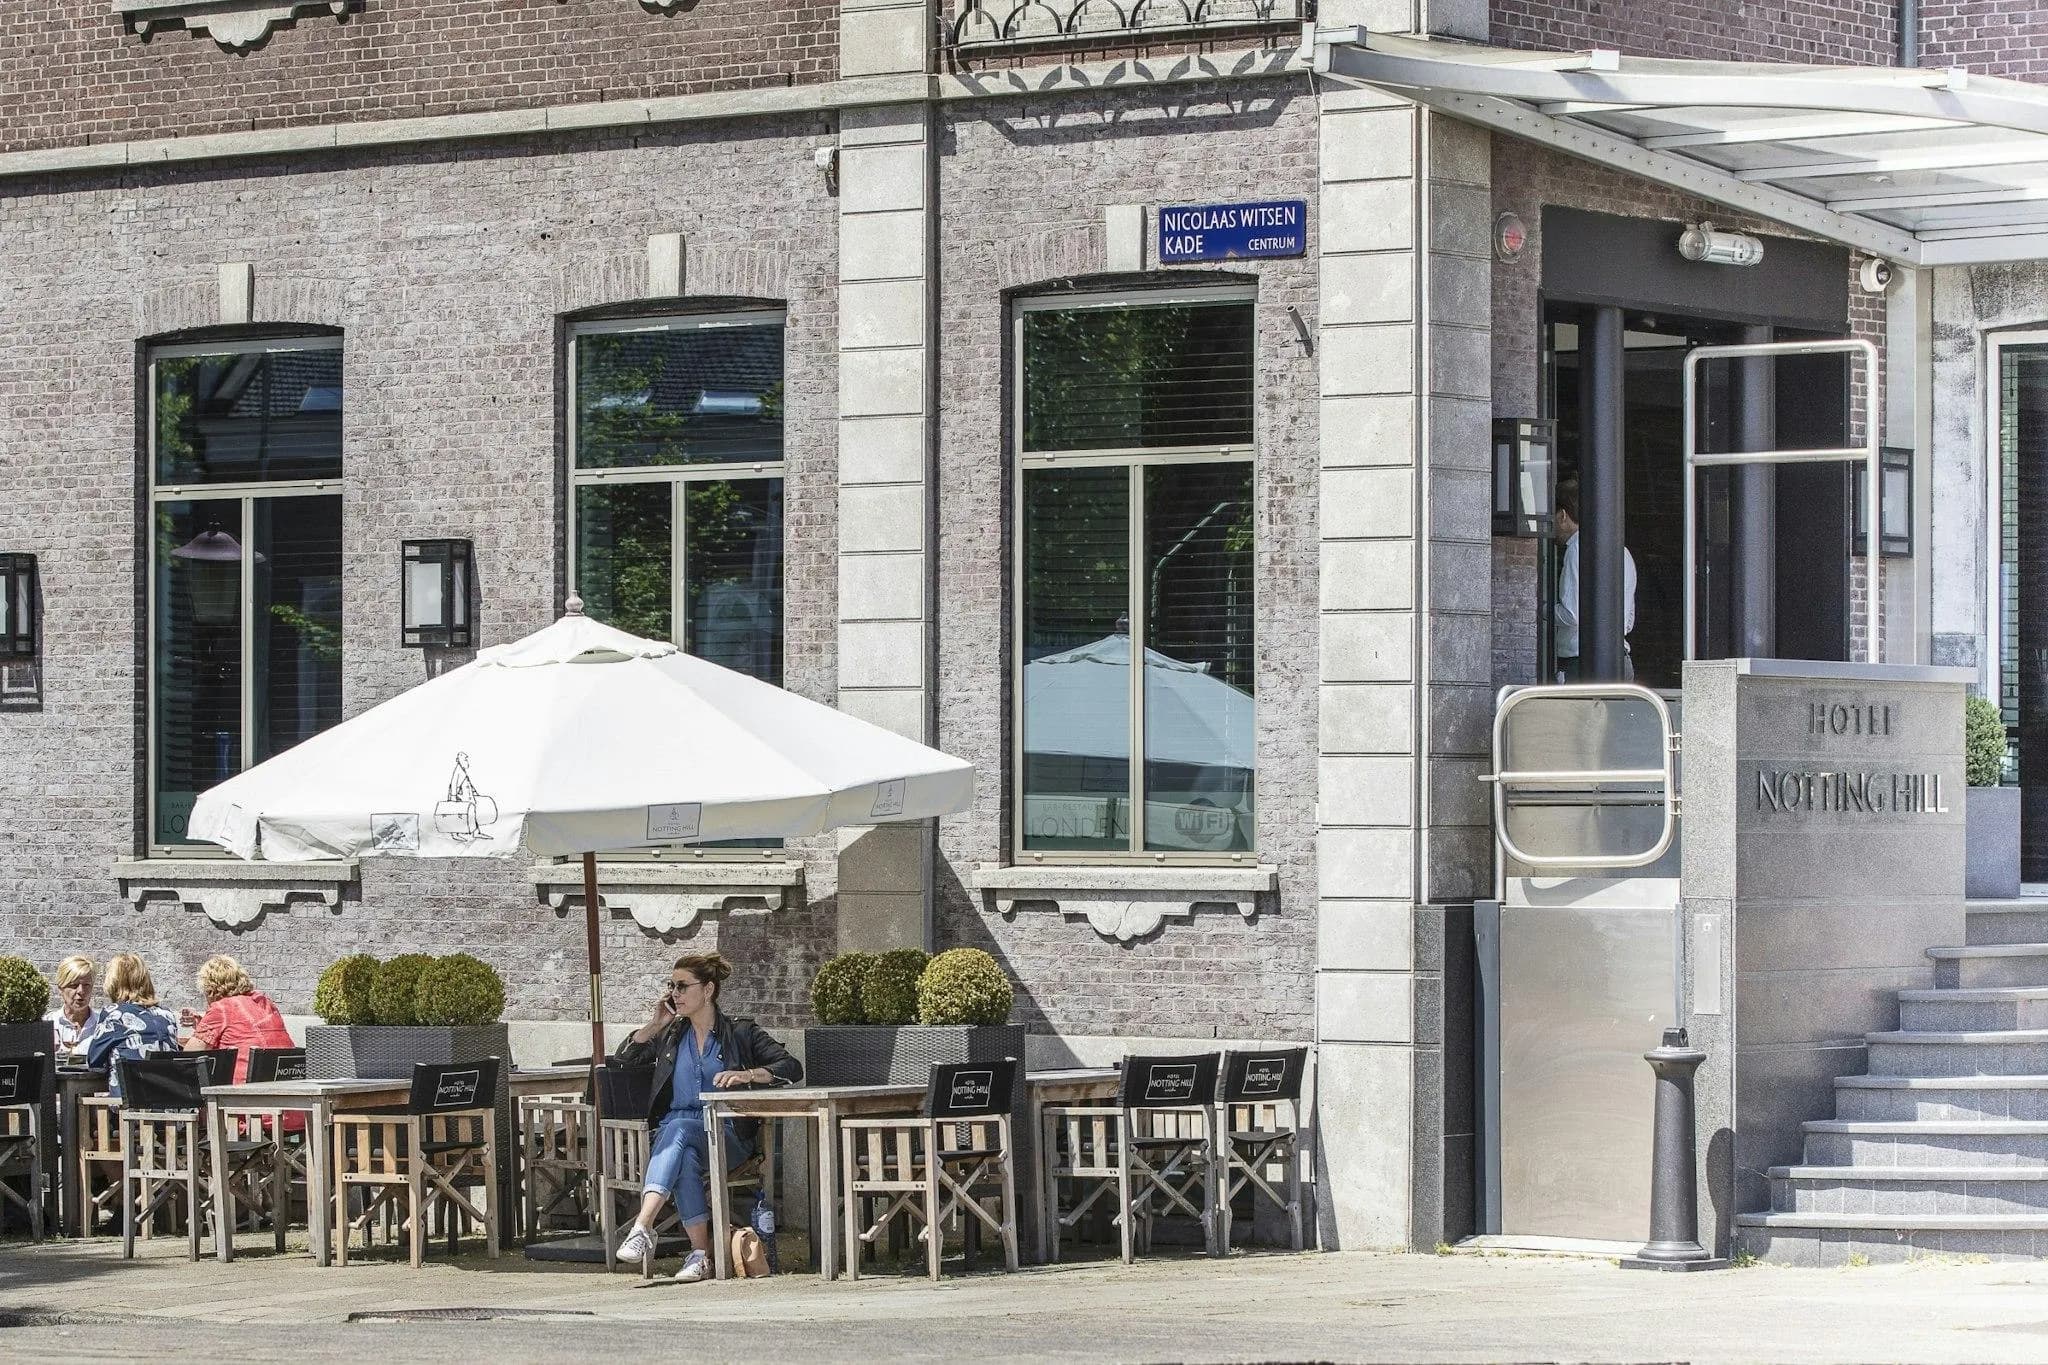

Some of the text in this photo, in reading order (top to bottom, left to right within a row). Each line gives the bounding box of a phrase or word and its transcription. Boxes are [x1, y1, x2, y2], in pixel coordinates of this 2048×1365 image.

[1165, 206, 1296, 231] NICOLAAS WITSEN
[1165, 235, 1203, 254] KADE
[1248, 236, 1295, 250] CENTRUM
[1808, 703, 1891, 735] HOTEL
[1757, 771, 1949, 813] NOTTING HILL
[1032, 817, 1128, 838] LONDEN
[1150, 1079, 1193, 1087] NOTTING HILL
[1247, 1073, 1271, 1081] NOTTING
[953, 1086, 976, 1094] NOTTING
